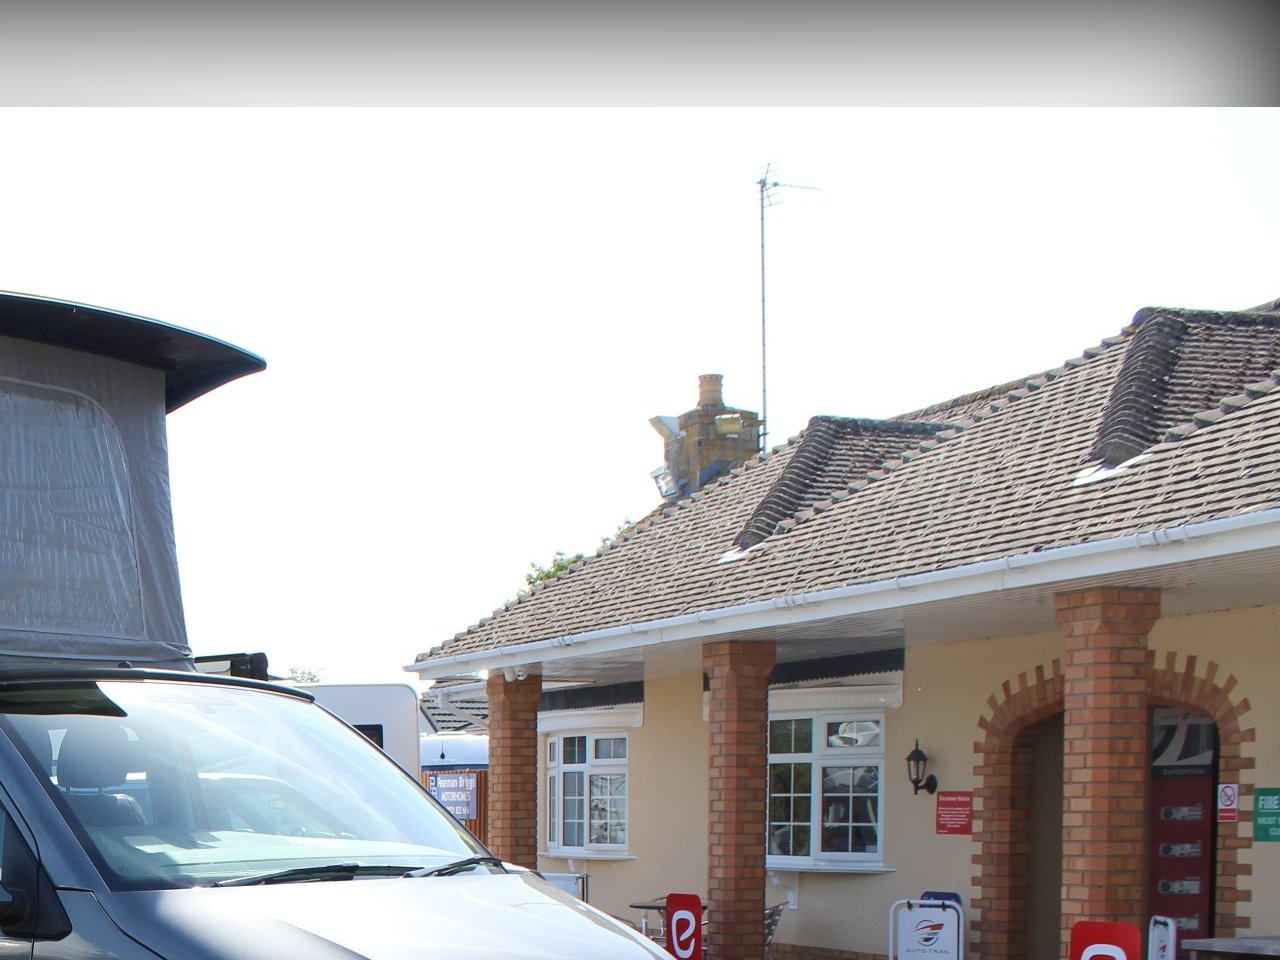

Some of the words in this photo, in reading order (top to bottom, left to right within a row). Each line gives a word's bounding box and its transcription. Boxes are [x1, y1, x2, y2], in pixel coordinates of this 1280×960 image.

[437, 776, 458, 788] Pearman
[458, 776, 476, 791] Briggs
[1258, 796, 1280, 809] FIRE
